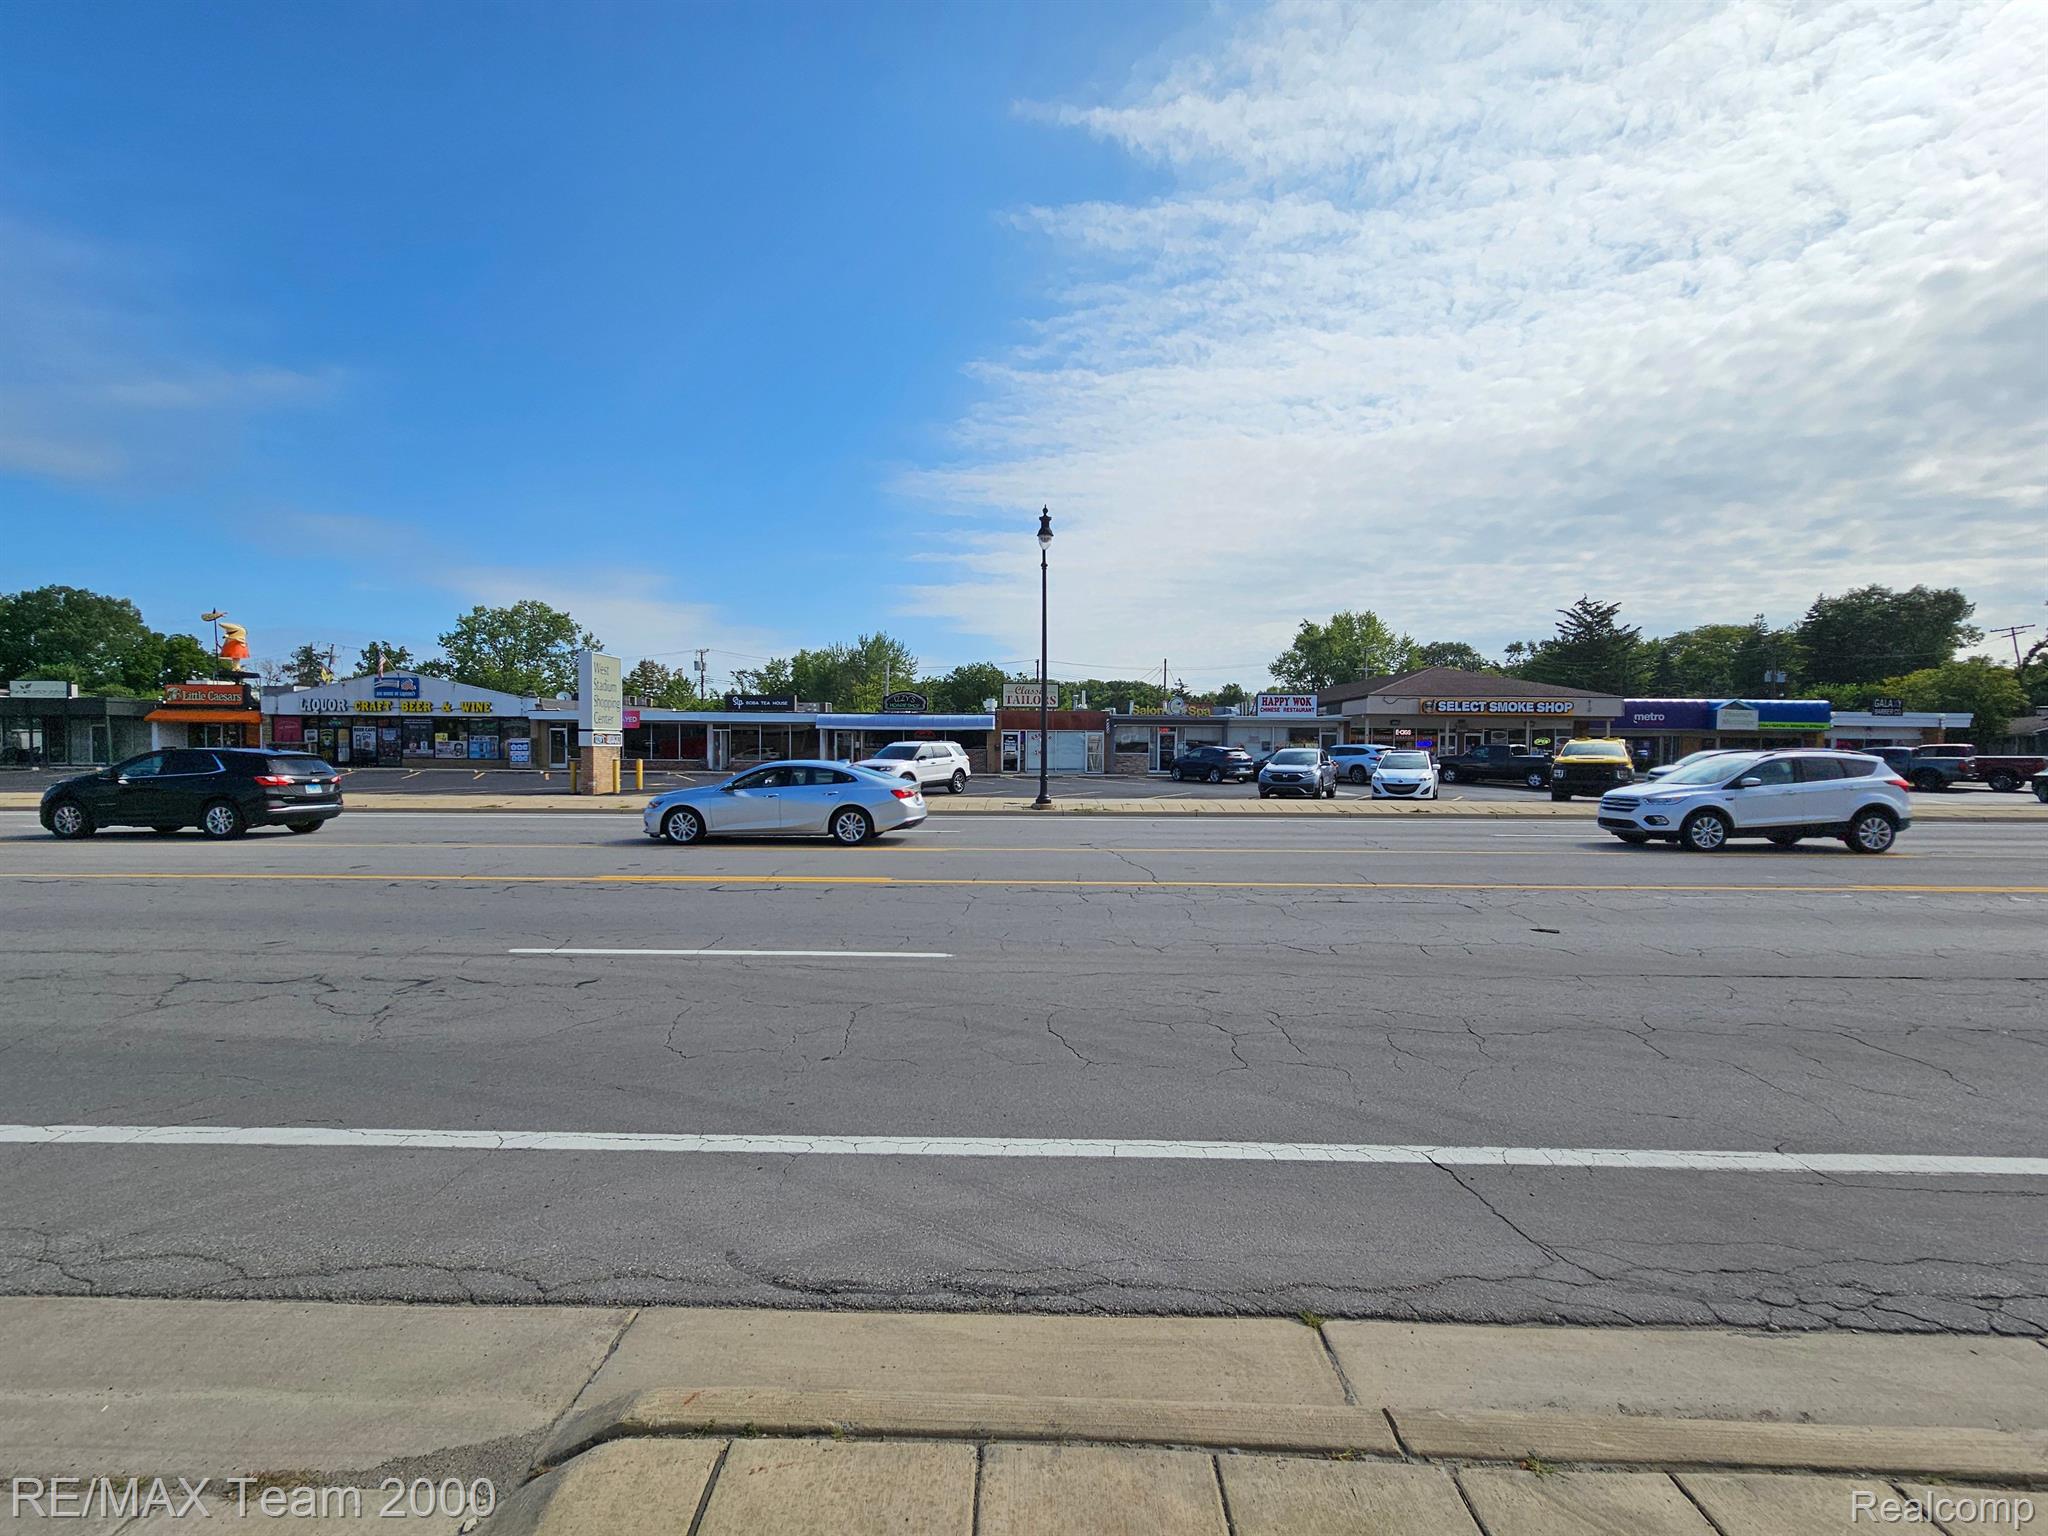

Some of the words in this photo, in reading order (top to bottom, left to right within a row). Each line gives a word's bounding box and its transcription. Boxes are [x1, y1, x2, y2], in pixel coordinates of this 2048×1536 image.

[593, 662, 609, 676] West
[593, 678, 618, 693] Stadium
[182, 690, 207, 701] Little
[207, 691, 241, 702] Caesars
[1005, 695, 1057, 705] TAILOS
[1261, 696, 1290, 706] HAPPY
[1292, 697, 1313, 707] WOK
[300, 698, 348, 714] LIQUOR
[353, 700, 393, 713] CRAFT
[400, 701, 433, 713] BEER
[441, 702, 453, 713] &
[461, 702, 493, 713] WINE
[593, 694, 621, 713] Shopping
[1437, 700, 1487, 713] SELECT
[1488, 701, 1535, 713] SMOKE
[1535, 702, 1574, 714] SHOP
[1132, 704, 1164, 716] Salon
[1188, 705, 1211, 717] Spa
[593, 711, 614, 724] Center
[1633, 712, 1665, 723] metro
